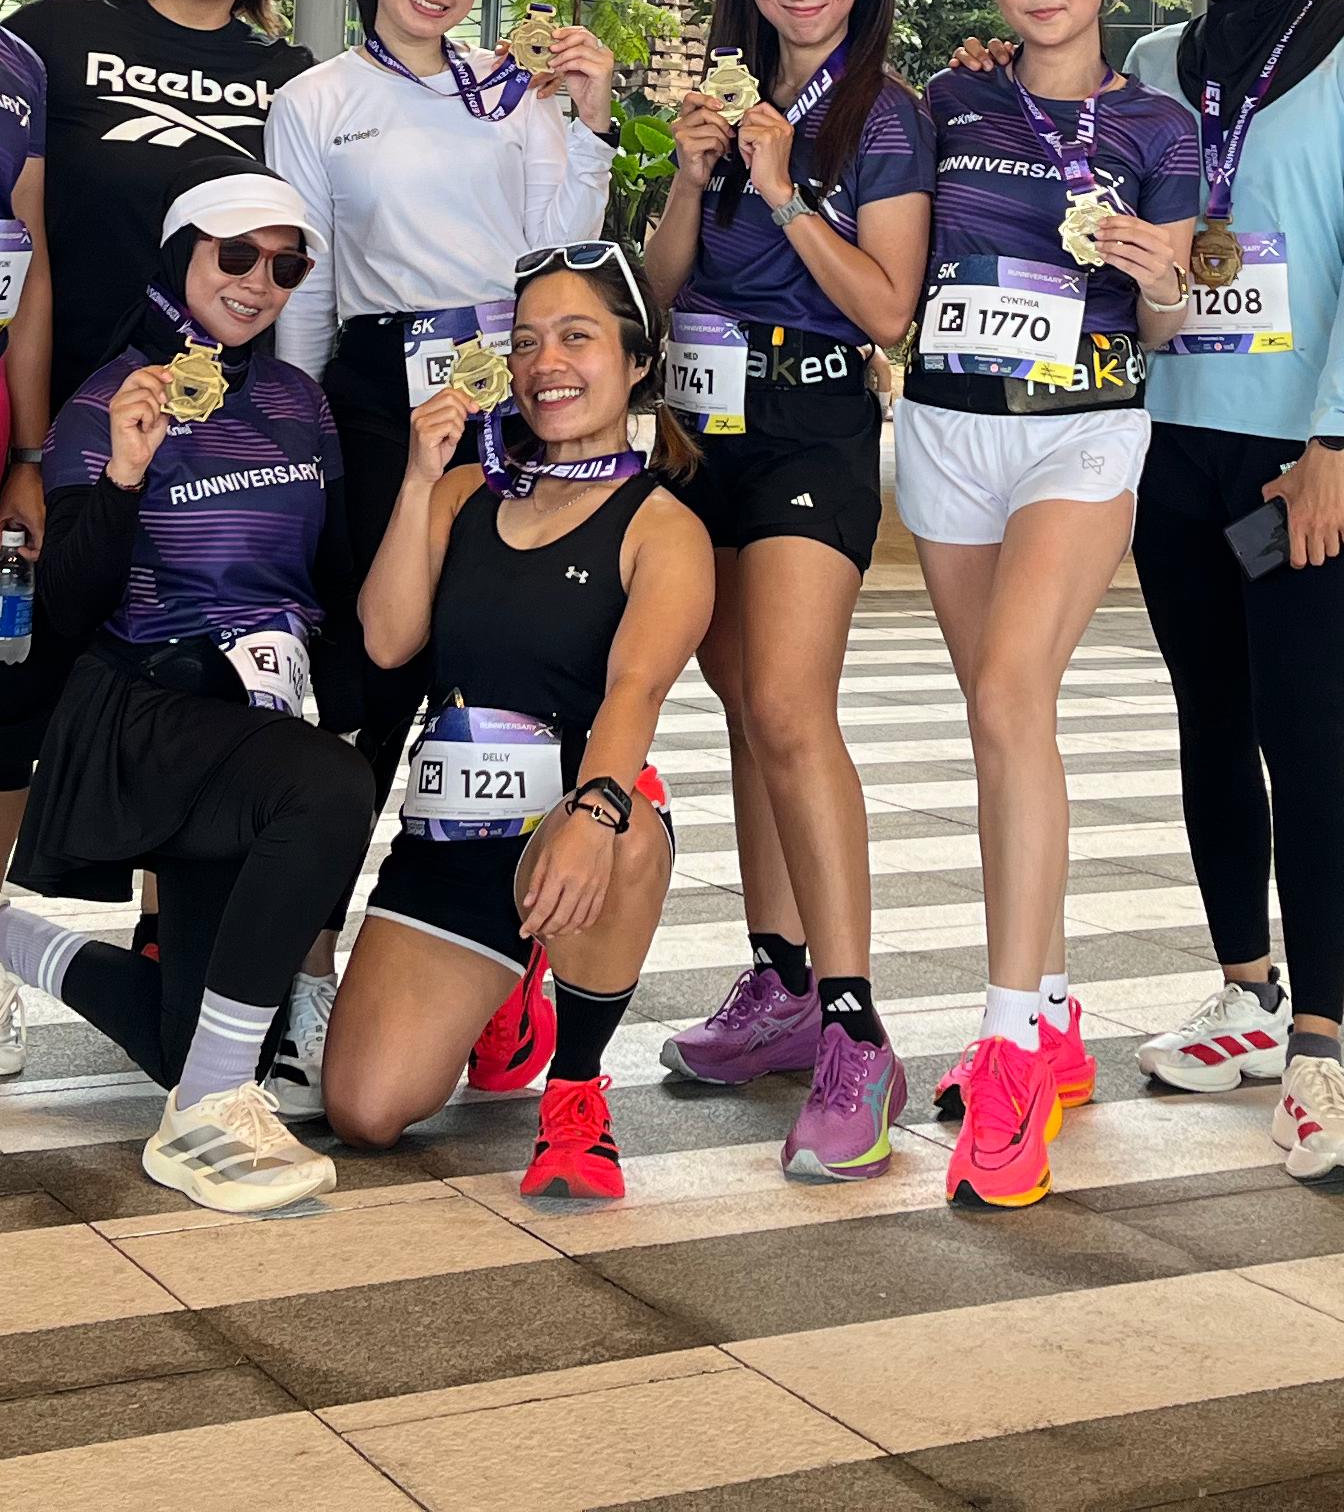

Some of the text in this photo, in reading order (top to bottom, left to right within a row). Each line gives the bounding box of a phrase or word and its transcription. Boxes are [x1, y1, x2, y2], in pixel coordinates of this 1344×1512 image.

[937, 262, 960, 279] 5K
[1000, 295, 1039, 308] CYNTHIA
[1192, 288, 1263, 315] 1208
[411, 317, 436, 335] 5K
[978, 309, 1051, 341] 1770
[672, 364, 713, 394] 1741
[169, 462, 320, 505] RUNNIVERSARY
[481, 752, 511, 763] DELLY
[460, 769, 526, 799] 1221
